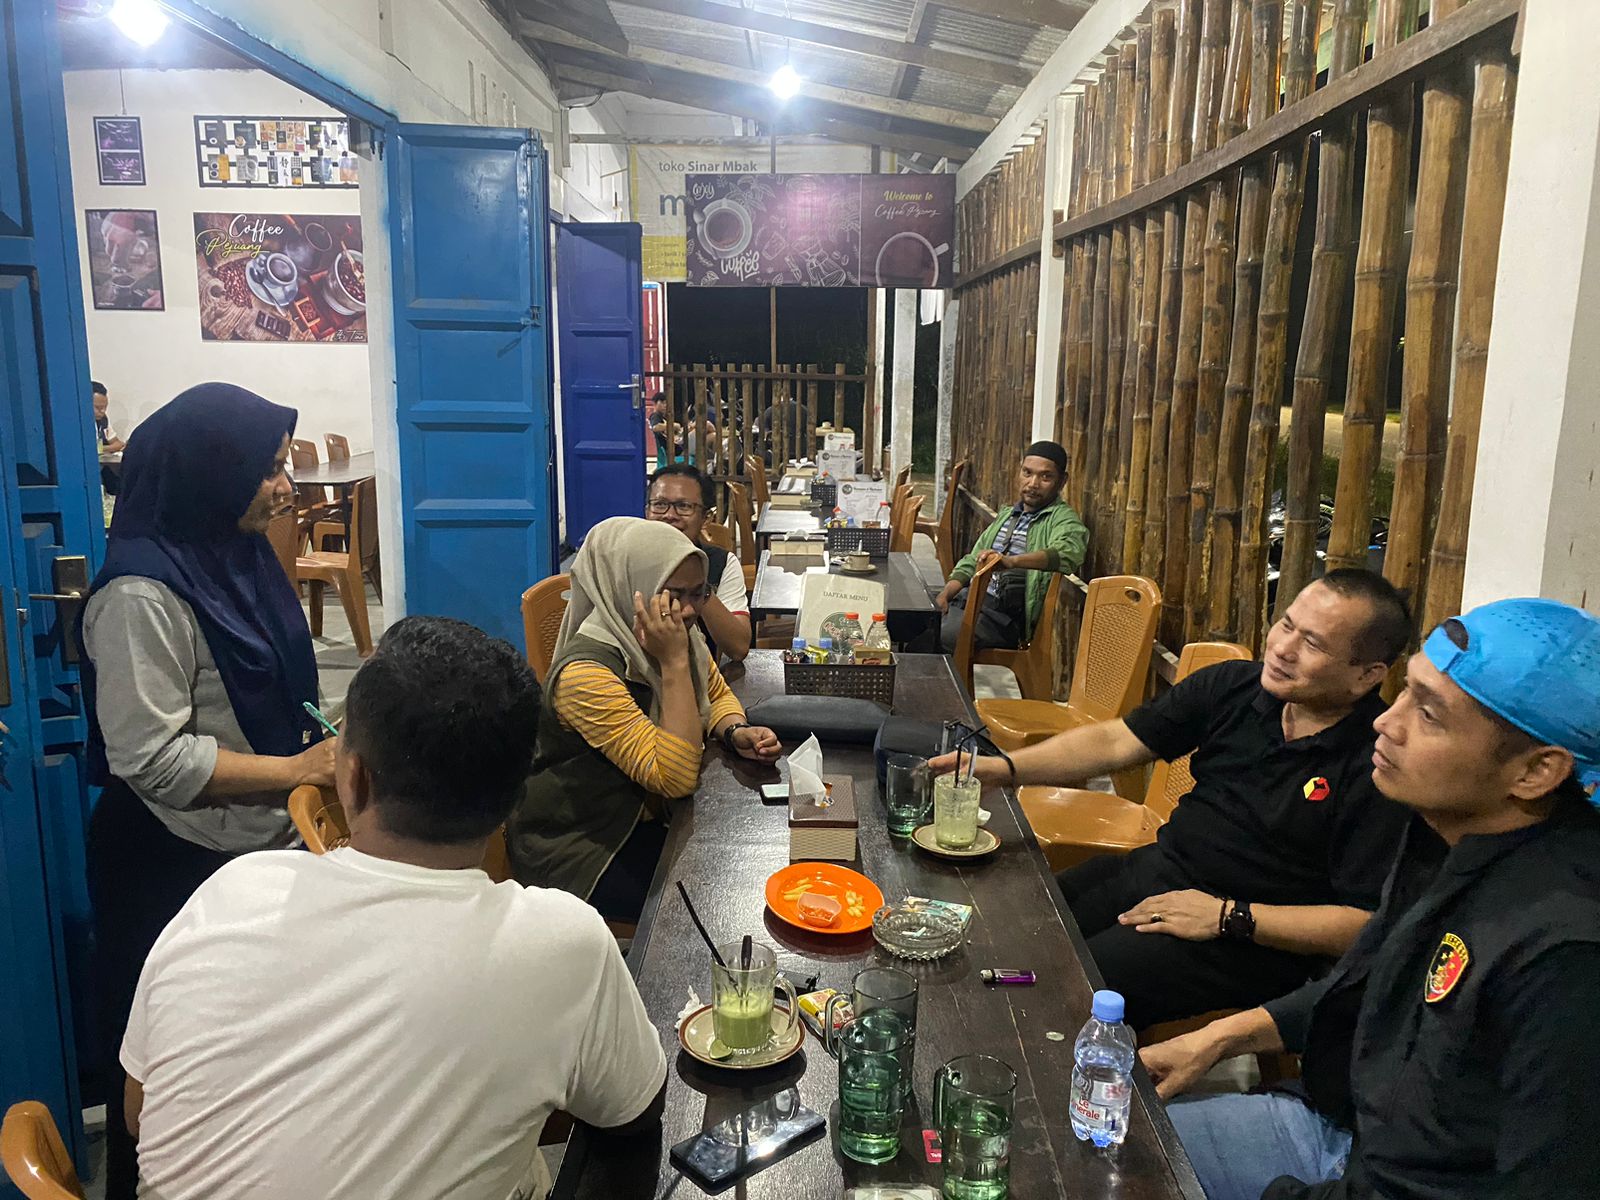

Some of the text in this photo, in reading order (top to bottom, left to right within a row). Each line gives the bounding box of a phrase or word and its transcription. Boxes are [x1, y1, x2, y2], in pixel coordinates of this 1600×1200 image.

[659, 160, 758, 172] toko Sinar Mbak
[228, 213, 284, 243] Coffee
[196, 228, 271, 258] Pejuang
[823, 591, 869, 602] DAFTAR MENU
